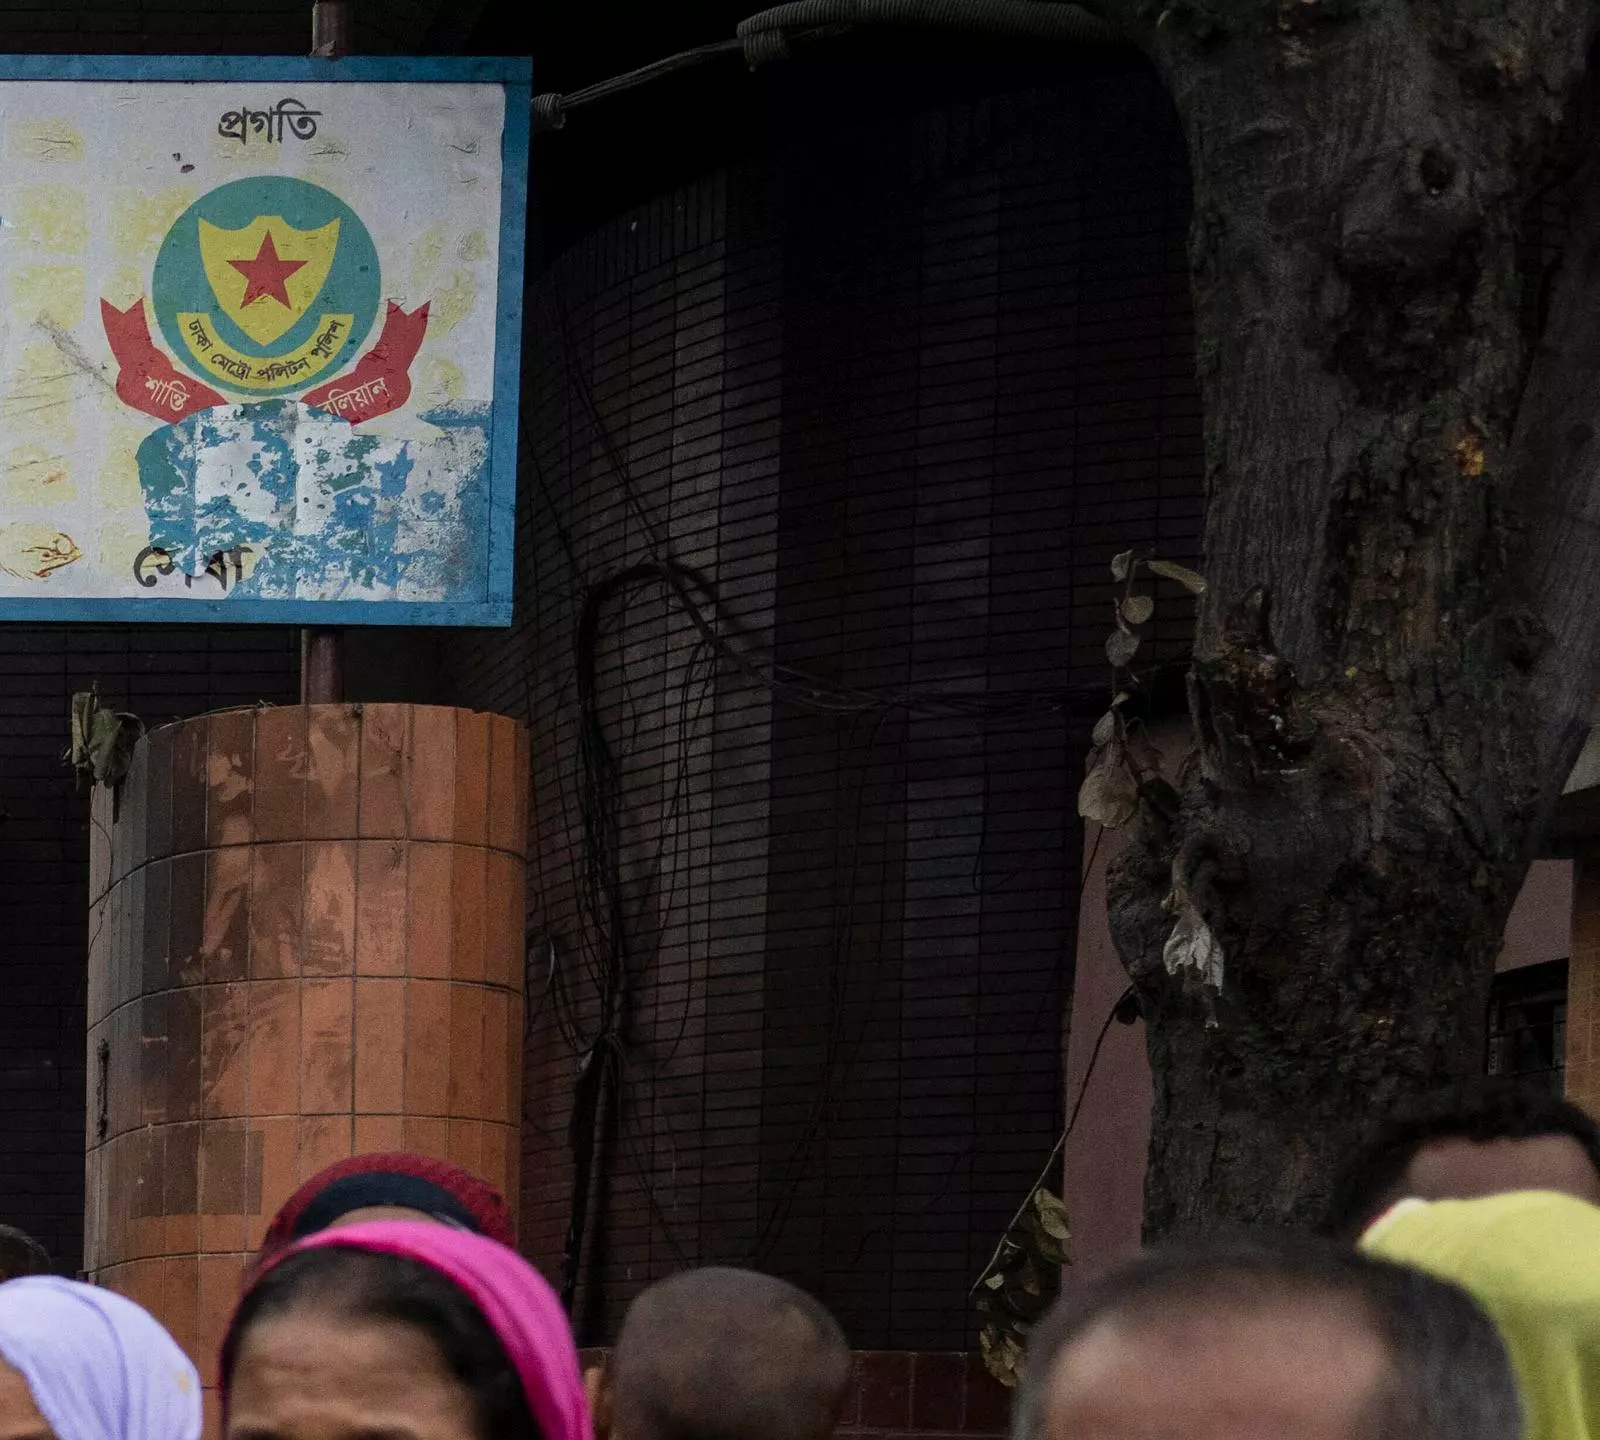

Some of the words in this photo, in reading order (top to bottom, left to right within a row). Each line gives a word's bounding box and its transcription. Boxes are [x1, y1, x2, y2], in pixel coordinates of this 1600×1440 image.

[218, 98, 323, 145] প্রগতি
[188, 318, 213, 352] ঢাকা
[310, 319, 345, 359] পুলিশ
[144, 375, 191, 412] শান্তি
